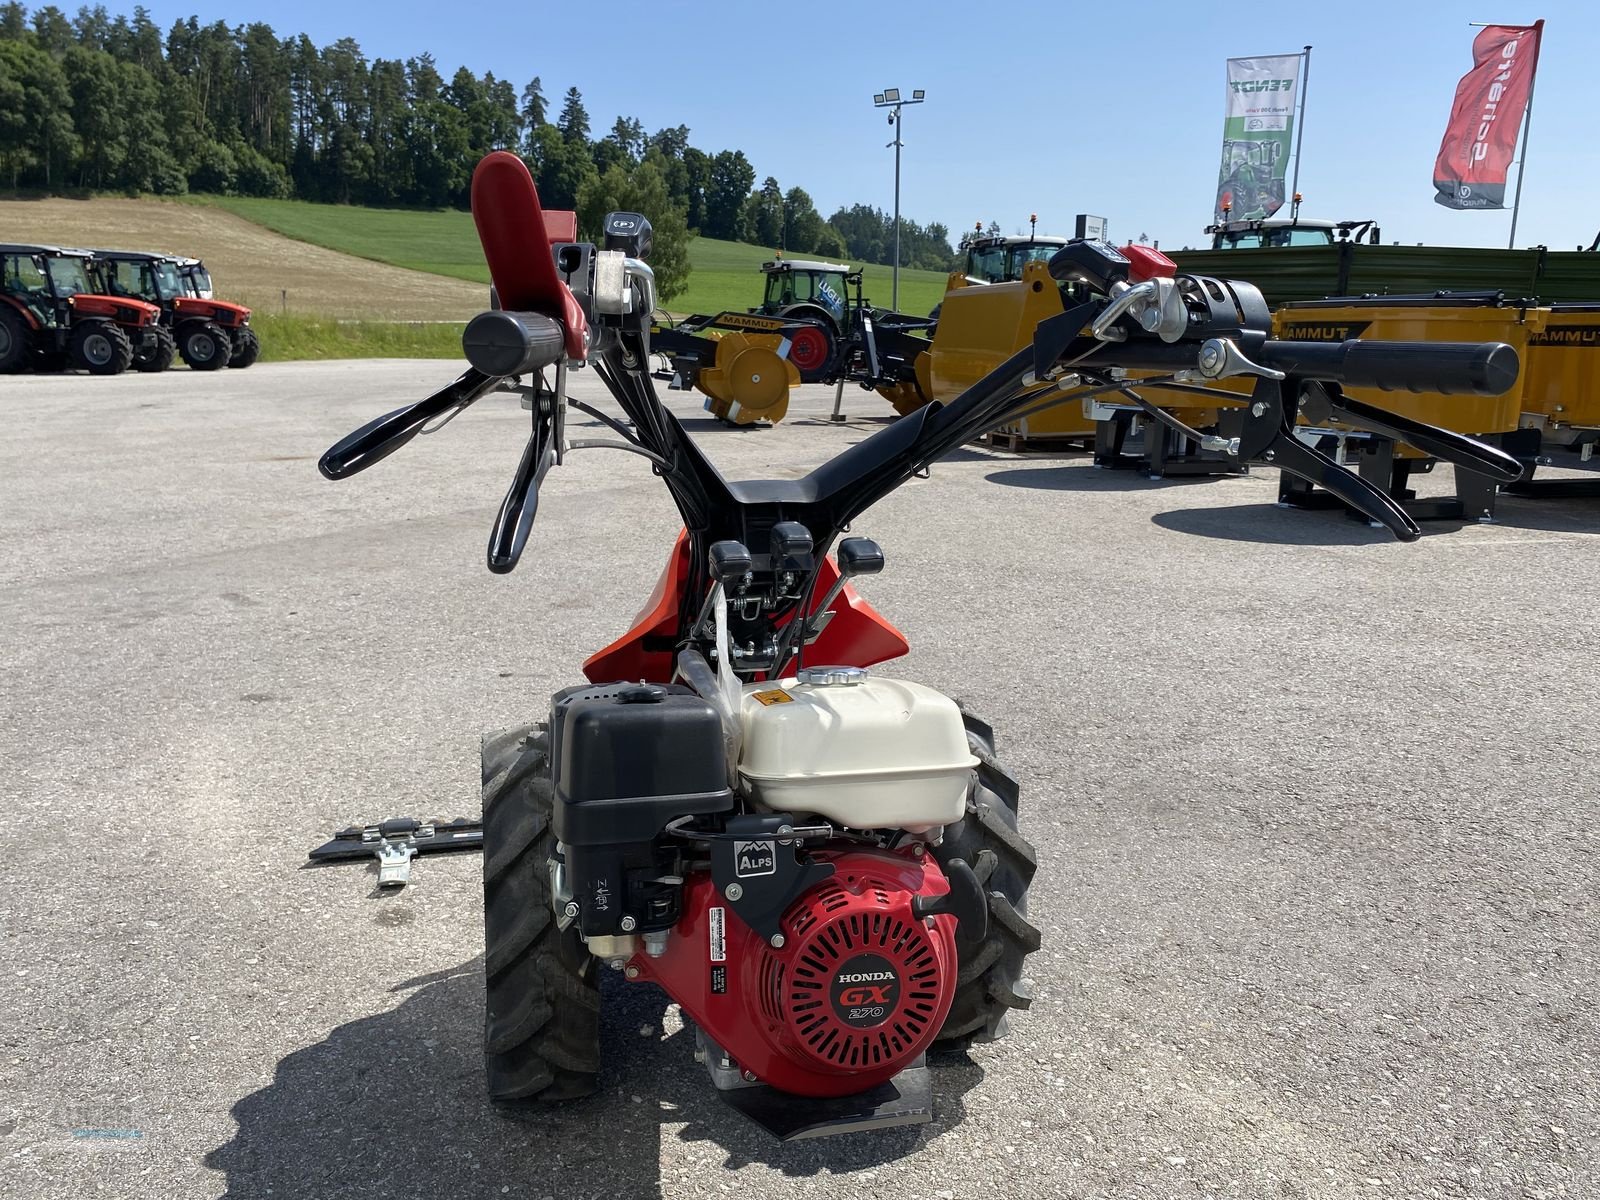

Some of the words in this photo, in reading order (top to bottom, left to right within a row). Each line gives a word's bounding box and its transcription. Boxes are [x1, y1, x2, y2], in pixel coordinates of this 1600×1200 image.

[818, 280, 843, 309] LUGER
[723, 315, 776, 329] MAMMUT
[1528, 330, 1600, 342] MAMMU
[740, 855, 773, 870] ALPS
[839, 971, 896, 983] HONDA
[839, 984, 893, 1006] GX
[848, 1006, 884, 1019] 270
